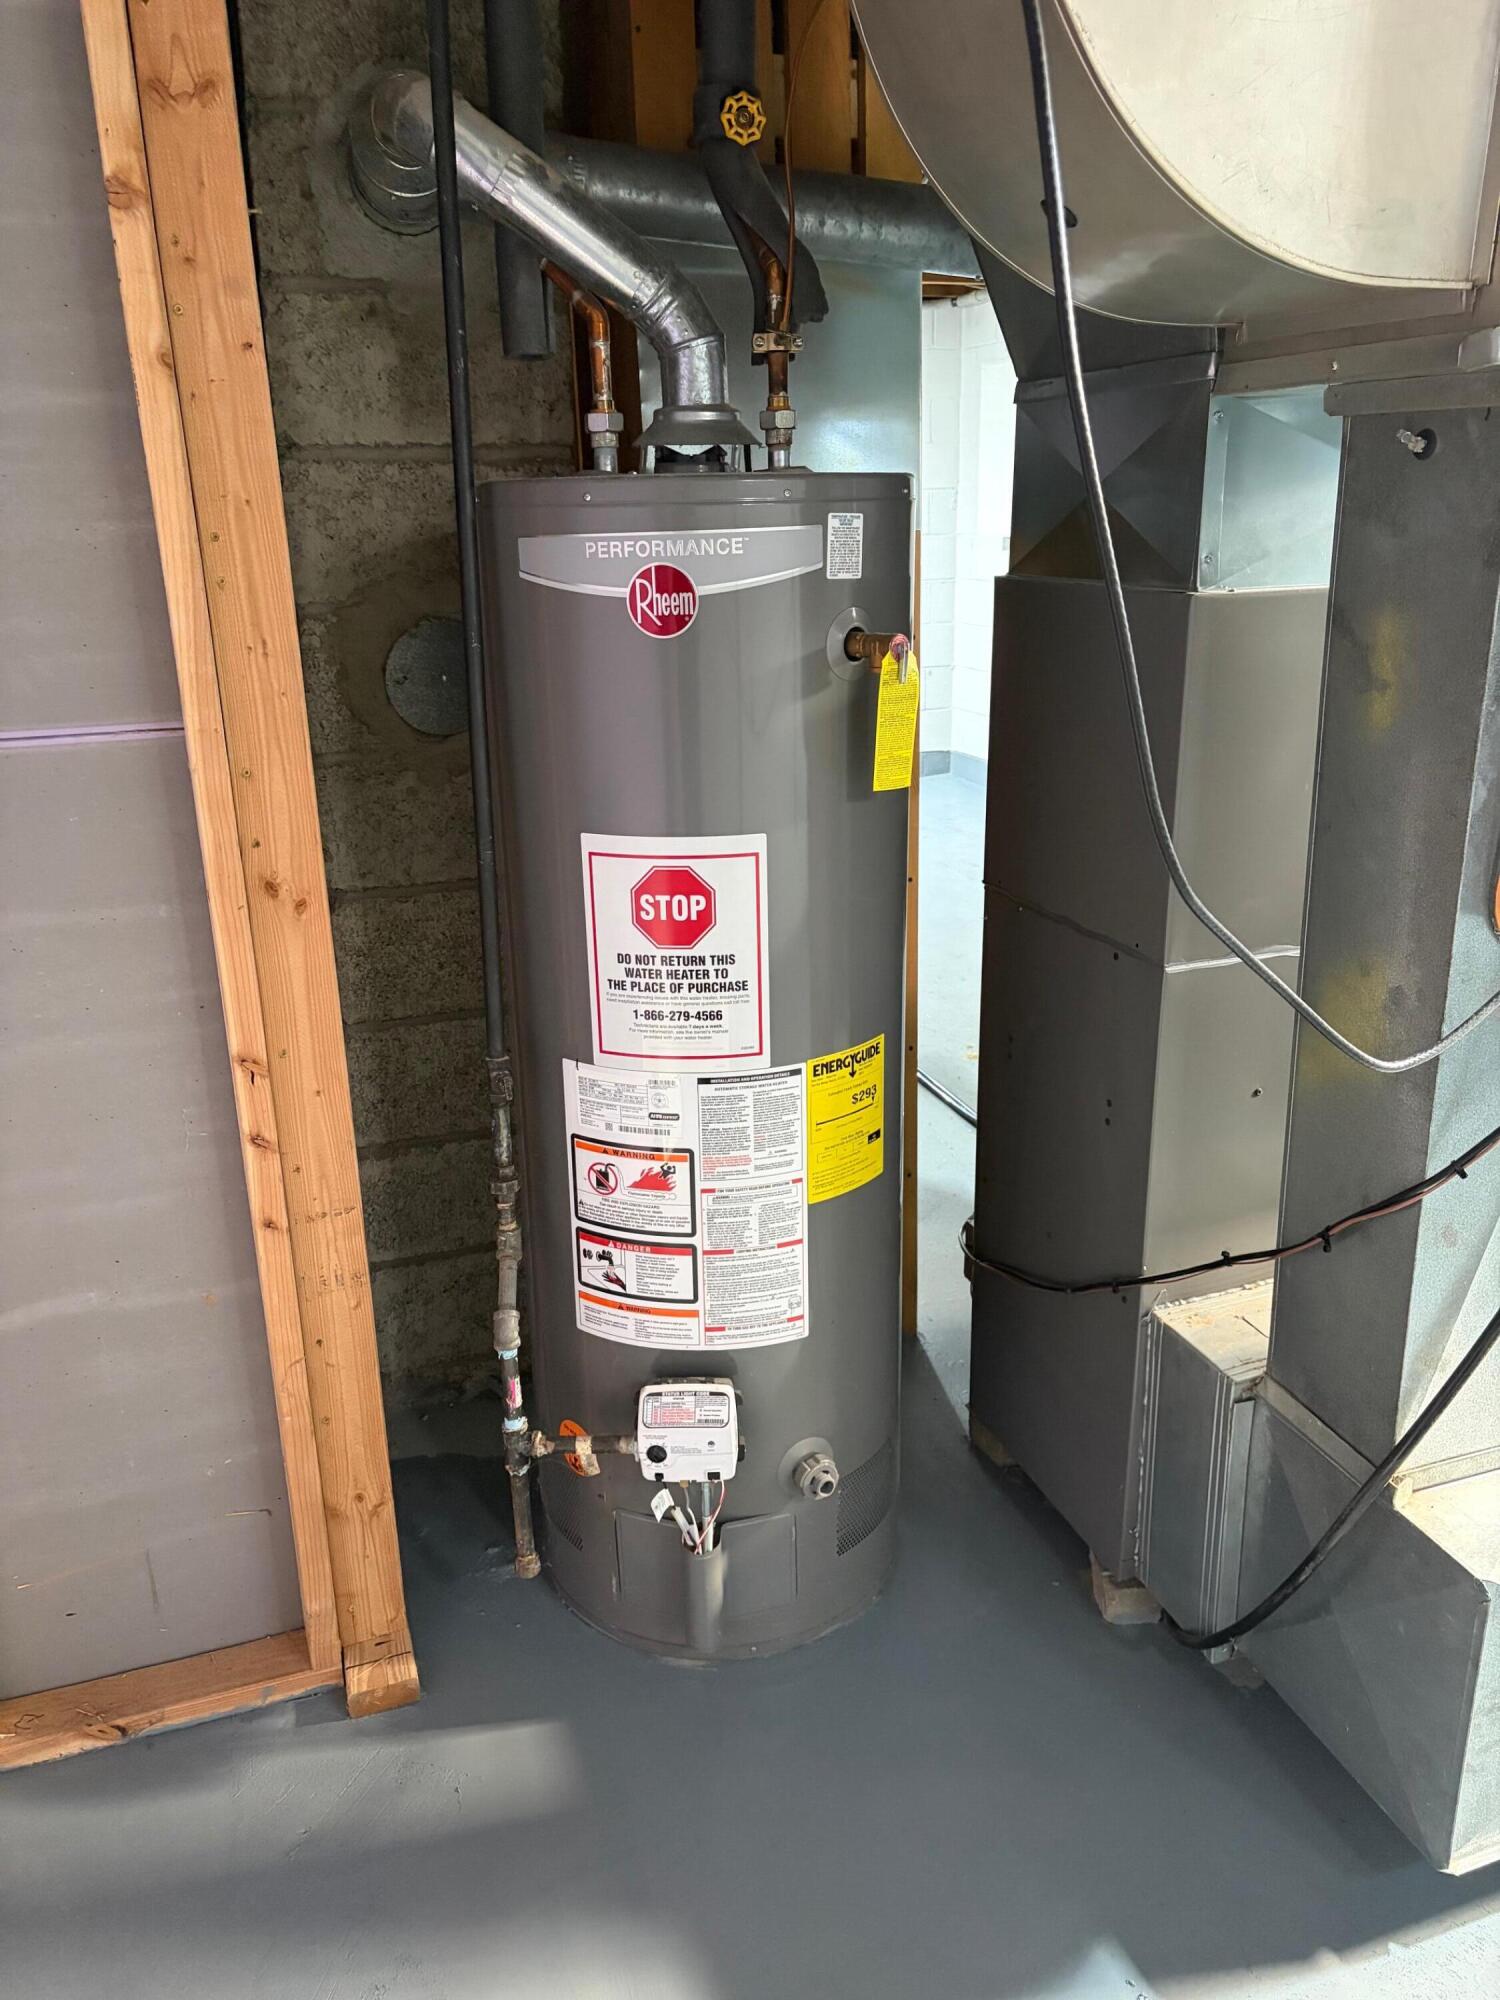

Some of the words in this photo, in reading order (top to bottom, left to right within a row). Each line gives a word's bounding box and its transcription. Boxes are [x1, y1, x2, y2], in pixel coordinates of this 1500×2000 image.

[635, 566, 694, 626] Rheem
[639, 893, 707, 921] STOP
[617, 953, 632, 965] DO
[635, 954, 657, 966] NOT
[660, 955, 706, 967] RETURN
[710, 954, 736, 966] THIS
[624, 967, 663, 980] WATER
[666, 969, 710, 980] HEATER
[714, 968, 729, 979] TO
[607, 979, 627, 991] THE
[631, 982, 666, 993] PLACE
[669, 982, 684, 994] OF
[688, 980, 749, 993] PURCHASE
[633, 1009, 723, 1022] 1-866-279-4566
[813, 1042, 880, 1077] ENERGYGUIDE
[612, 1149, 656, 1161] WARNING
[616, 1242, 652, 1253] DANGER
